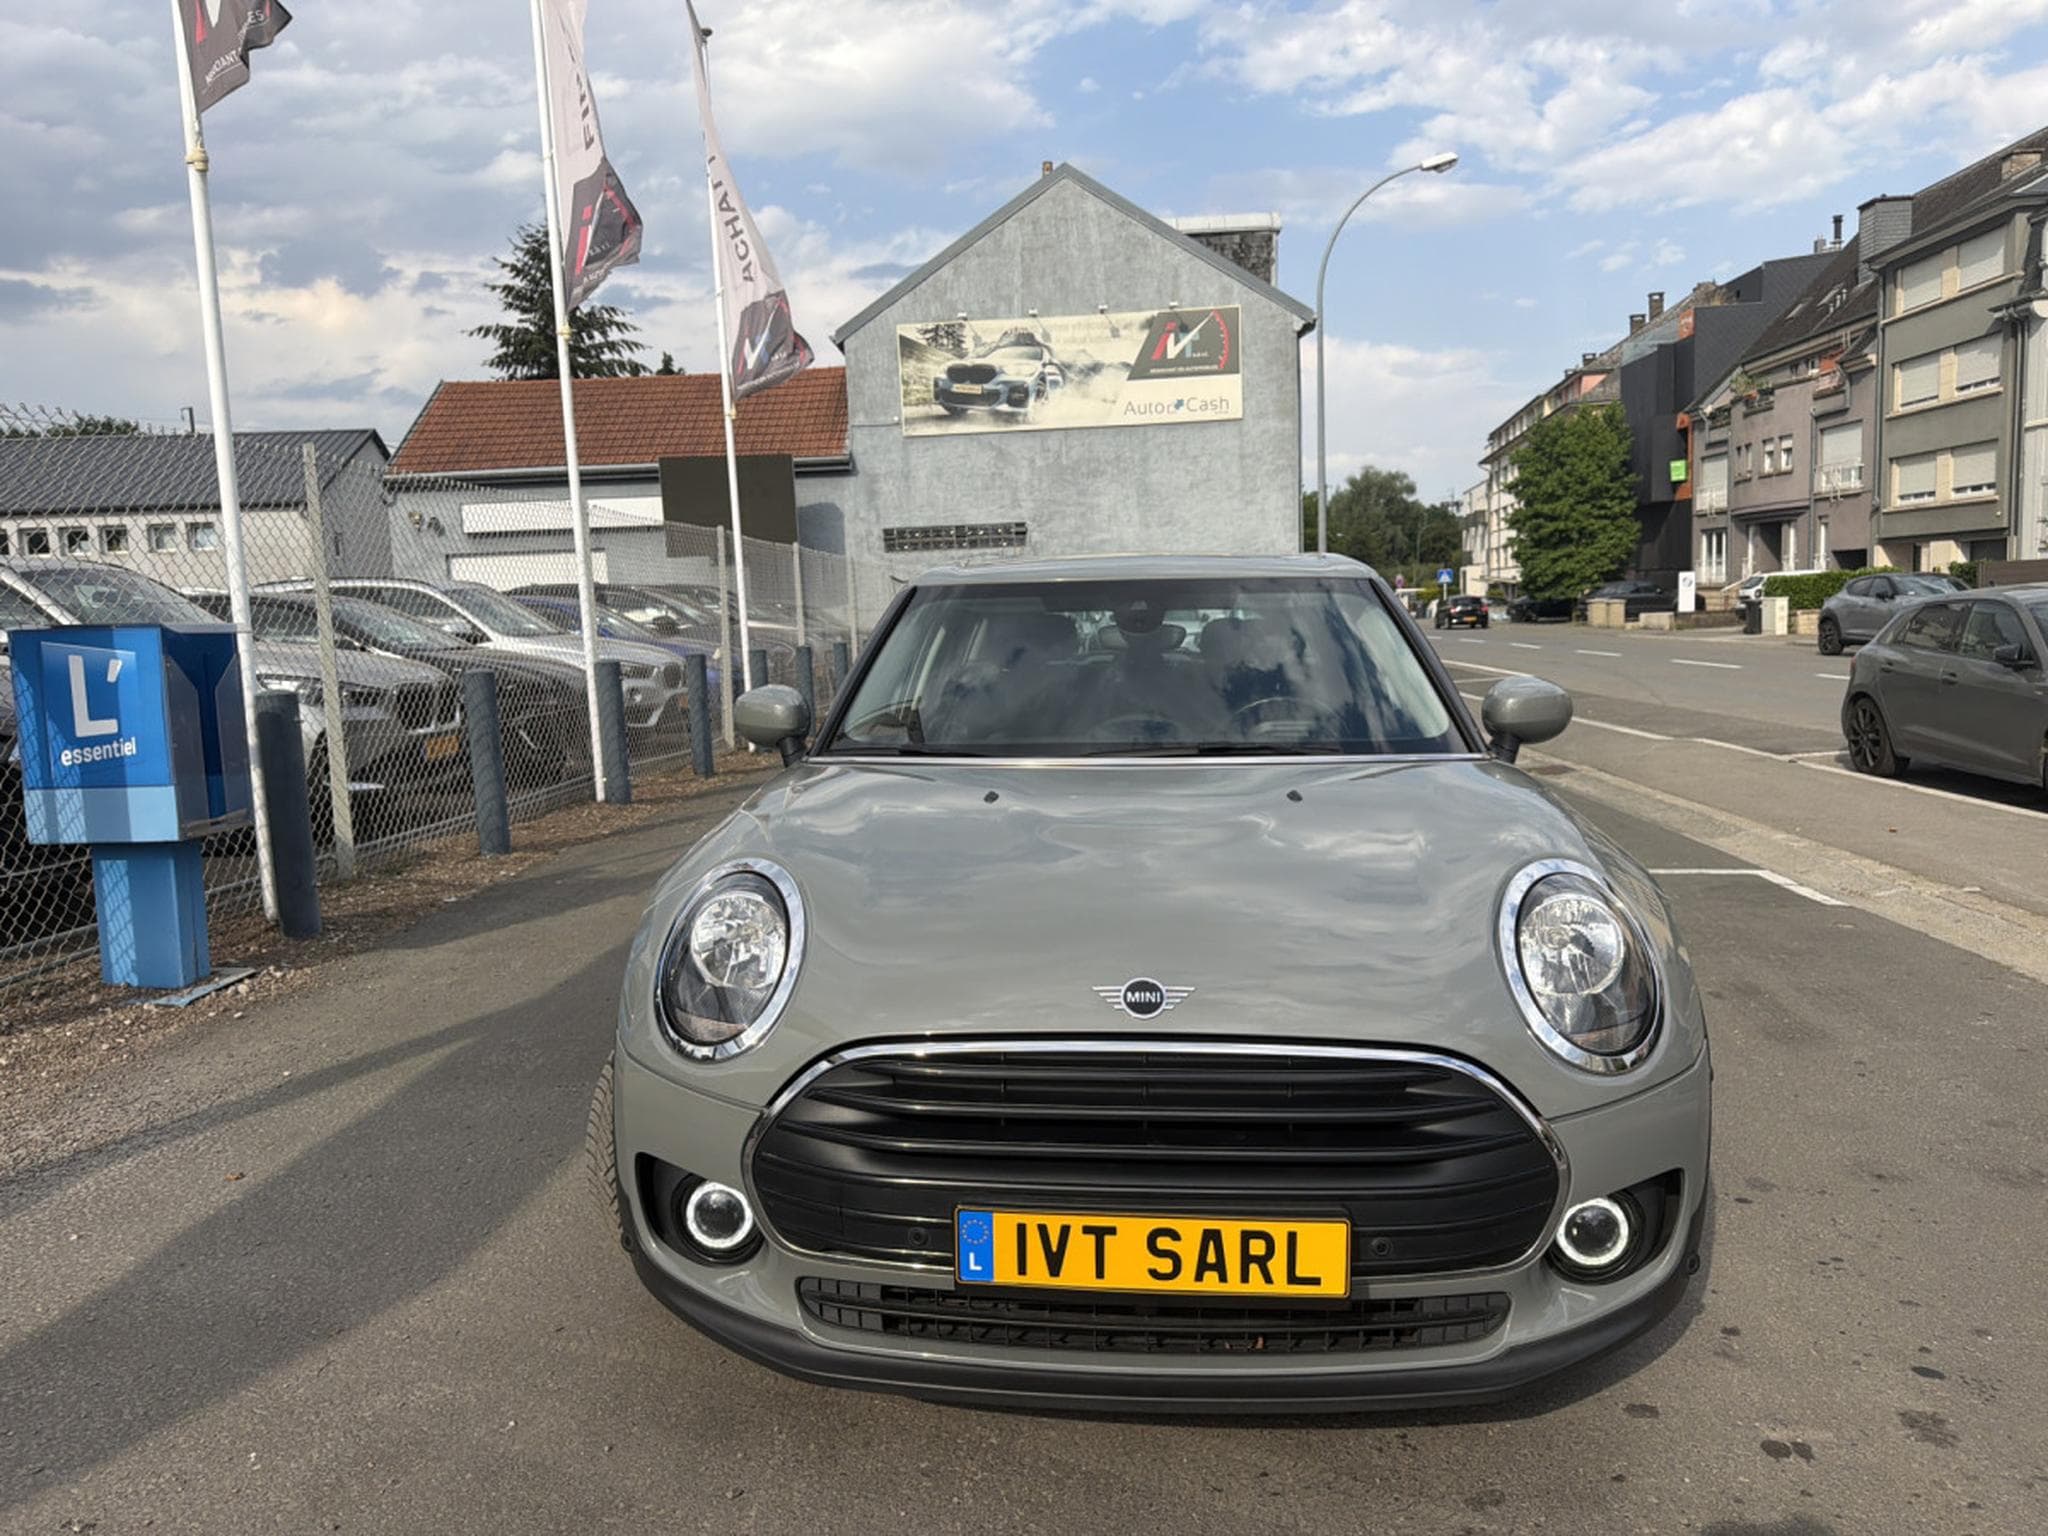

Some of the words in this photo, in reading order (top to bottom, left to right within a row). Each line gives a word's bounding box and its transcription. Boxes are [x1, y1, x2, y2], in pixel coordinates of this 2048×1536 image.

[1186, 396, 1230, 413] Cash
[60, 736, 137, 767] essentiel
[1126, 991, 1161, 1003] MINI
[968, 1251, 983, 1271] L
[1016, 1222, 1118, 1281] IVT
[1145, 1227, 1322, 1287] SARL
